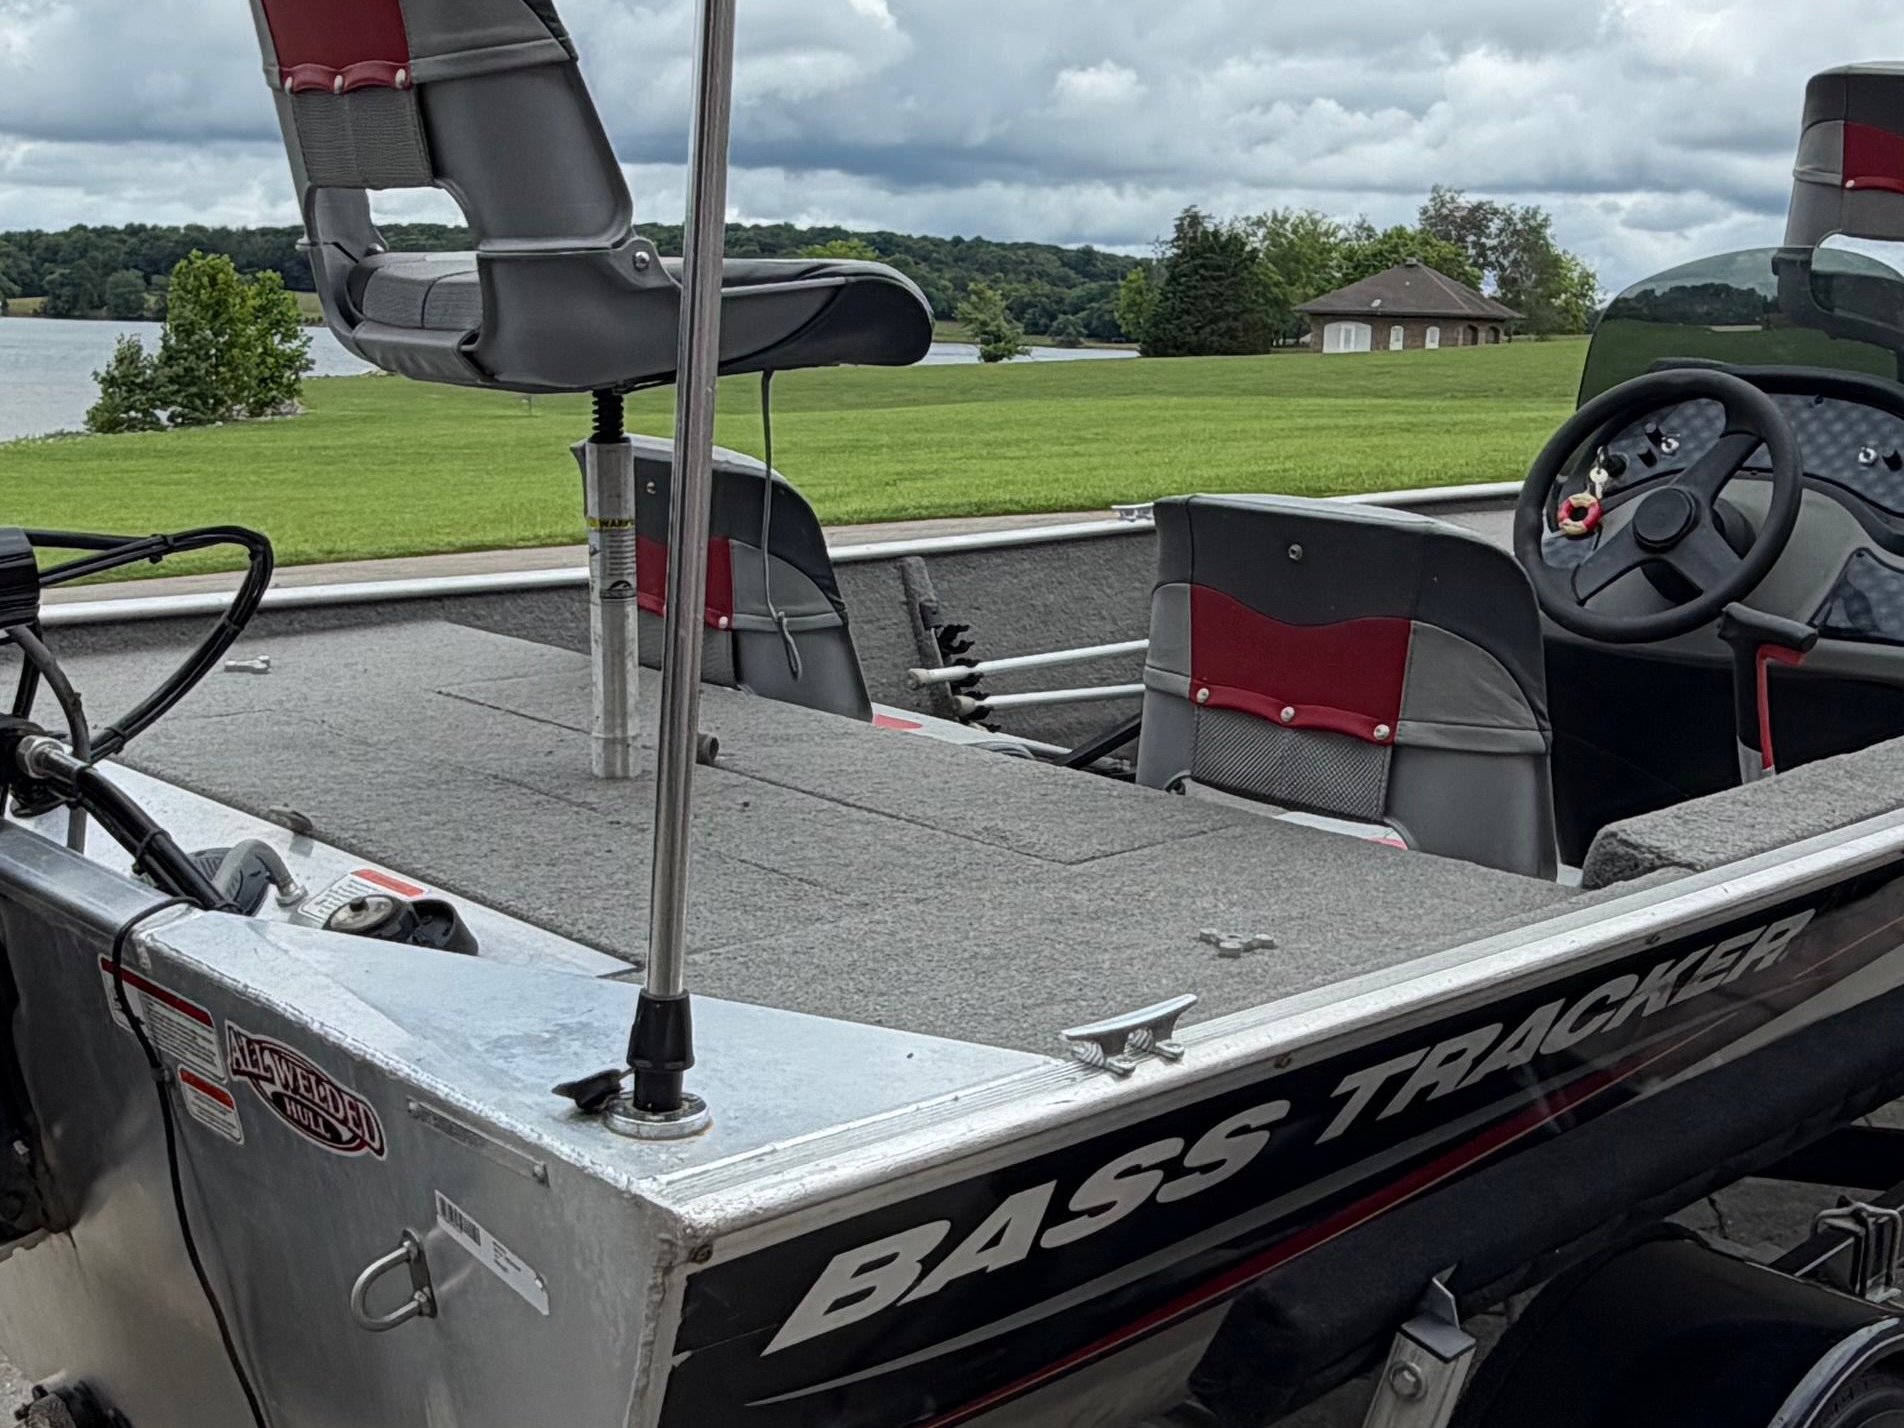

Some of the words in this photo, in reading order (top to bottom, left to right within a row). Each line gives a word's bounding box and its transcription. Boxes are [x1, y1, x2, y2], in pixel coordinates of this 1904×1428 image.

[229, 1028, 273, 1078] ALL
[270, 1049, 381, 1150] WELDED
[284, 1100, 332, 1139] HULL
[759, 1099, 1291, 1358] BASS
[1314, 907, 1817, 1145] TRACKER
